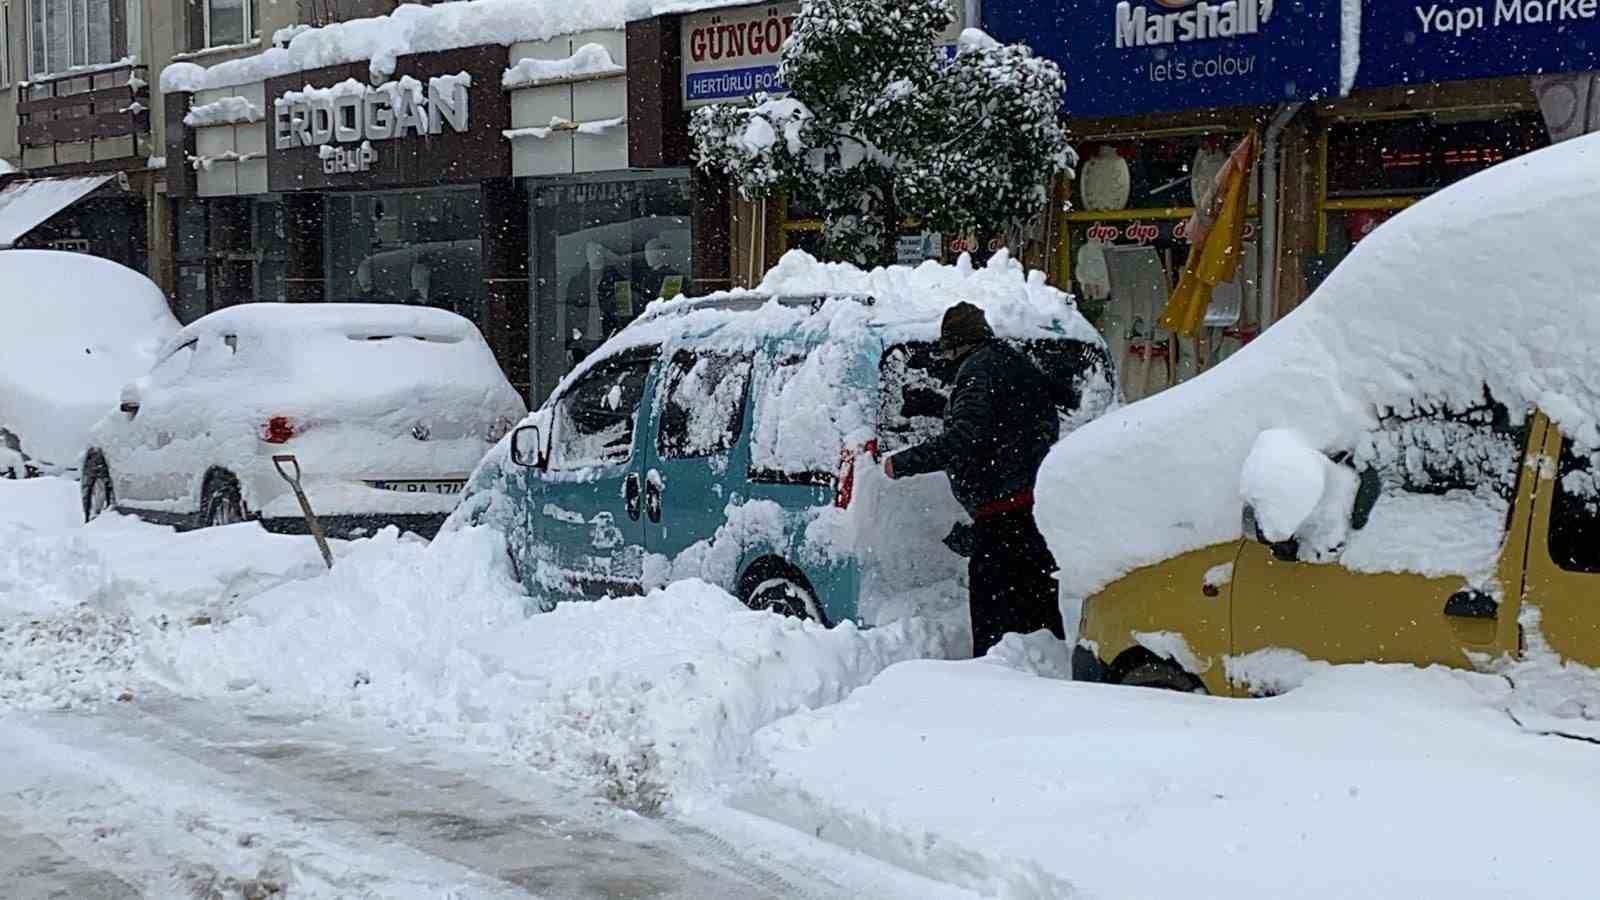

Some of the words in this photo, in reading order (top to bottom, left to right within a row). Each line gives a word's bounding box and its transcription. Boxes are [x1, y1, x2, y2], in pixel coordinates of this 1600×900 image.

[1115, 0, 1258, 48] Marshall
[1415, 4, 1483, 37] Yapı
[1192, 55, 1256, 76] colour
[693, 73, 752, 94] HERTÜRLÜ
[321, 143, 377, 174] GRUP
[1088, 222, 1119, 241] dyo
[1126, 221, 1159, 245] dyo
